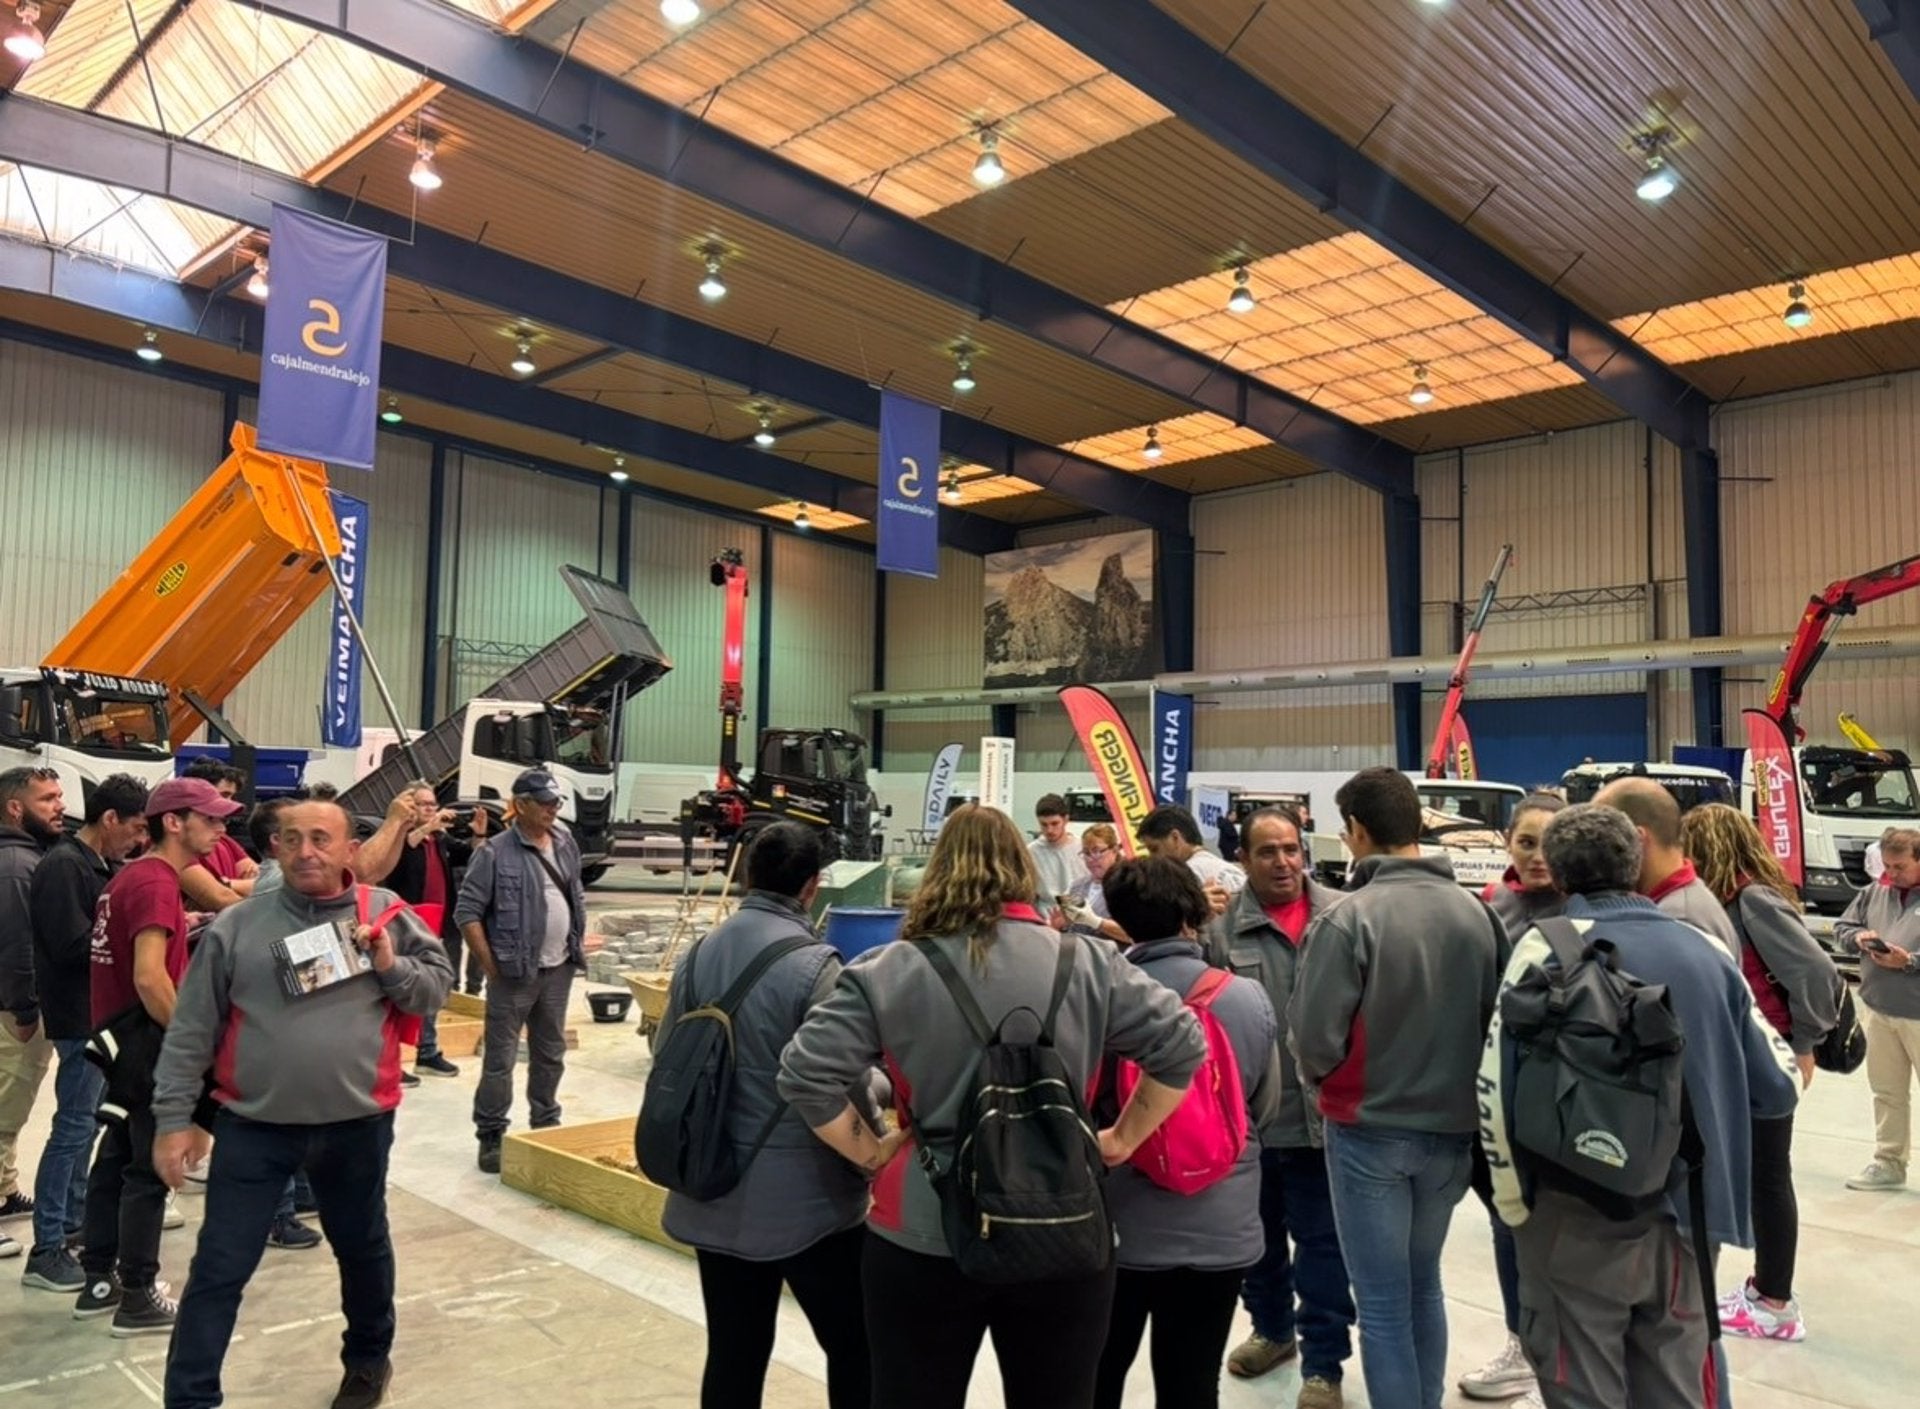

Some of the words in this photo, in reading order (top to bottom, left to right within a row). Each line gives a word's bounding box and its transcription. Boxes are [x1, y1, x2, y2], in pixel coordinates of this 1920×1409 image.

[271, 353, 370, 387] cajalmendralejo
[336, 515, 358, 727] VEIMANCHA
[1160, 709, 1181, 802] ANCHA
